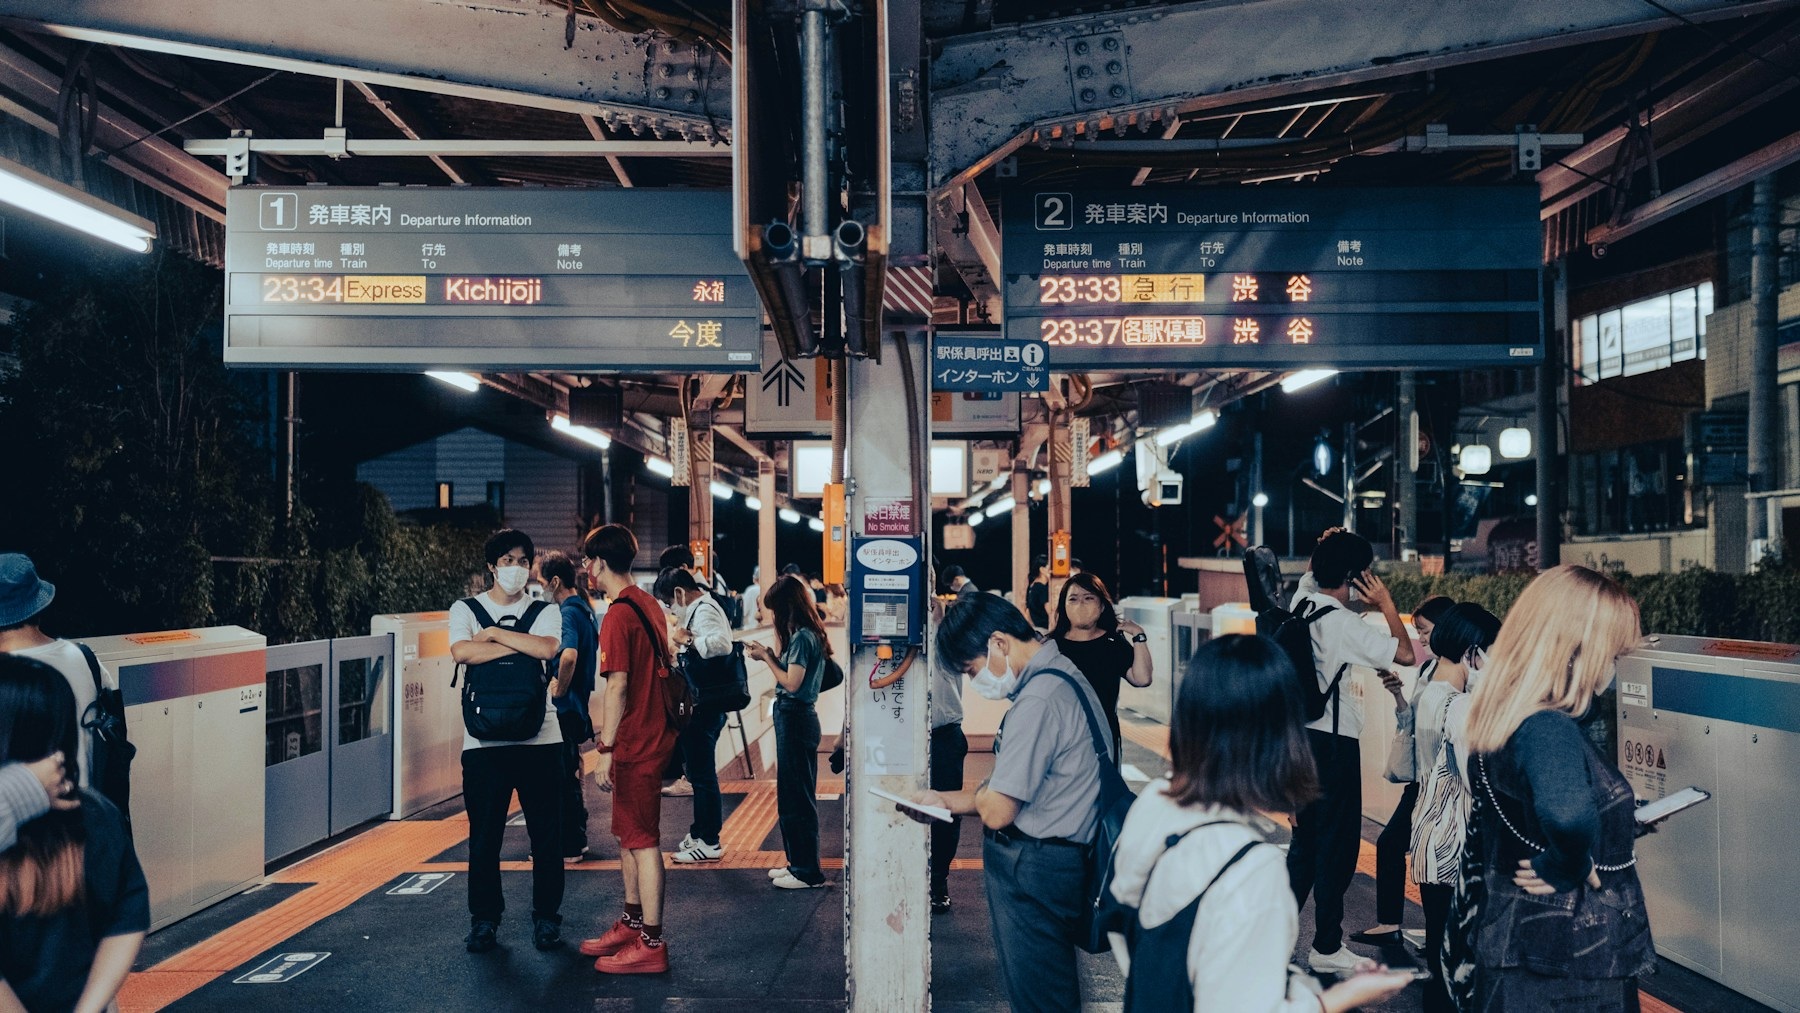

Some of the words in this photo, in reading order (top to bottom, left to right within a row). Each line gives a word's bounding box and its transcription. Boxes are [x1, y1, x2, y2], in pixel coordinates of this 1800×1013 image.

[270, 197, 284, 226] 1
[309, 203, 392, 226] 発車案内
[400, 214, 461, 228] Departure
[465, 214, 532, 226] Information
[1043, 197, 1065, 226] 2
[1085, 202, 1168, 225] 発車案内
[1177, 212, 1238, 226] Departure
[1242, 211, 1310, 224] Information
[266, 242, 315, 256] 発車時刻
[340, 242, 365, 256] 種別
[421, 243, 446, 256] 行先
[557, 244, 582, 257] 備考
[1043, 243, 1093, 256] 発車時刻
[1118, 242, 1143, 256] 種別
[1200, 242, 1225, 255] 行先
[1337, 240, 1362, 254] 備考
[265, 258, 310, 270] Departure
[314, 258, 333, 269] time
[340, 258, 368, 269] Train
[421, 258, 437, 269] To
[557, 260, 583, 270] Note
[1043, 258, 1089, 270] Departure
[1092, 258, 1111, 269] time
[1118, 258, 1146, 268] Train
[1200, 257, 1216, 268] To
[1337, 256, 1364, 266] Note
[263, 277, 343, 302] 23:34
[347, 280, 423, 301] Express
[446, 278, 541, 304] Kichijōji
[1040, 276, 1122, 303] 23:33
[668, 320, 722, 348] 今度
[1040, 318, 1122, 345] 23:37
[1125, 319, 1204, 343] 各駅停車
[937, 346, 1002, 362] 駅係員呼出
[938, 368, 1020, 384] インターホン
[867, 505, 910, 520] 終日禁煙
[868, 522, 878, 531] No
[880, 522, 910, 532] Smoking
[872, 558, 912, 566] インターホン
